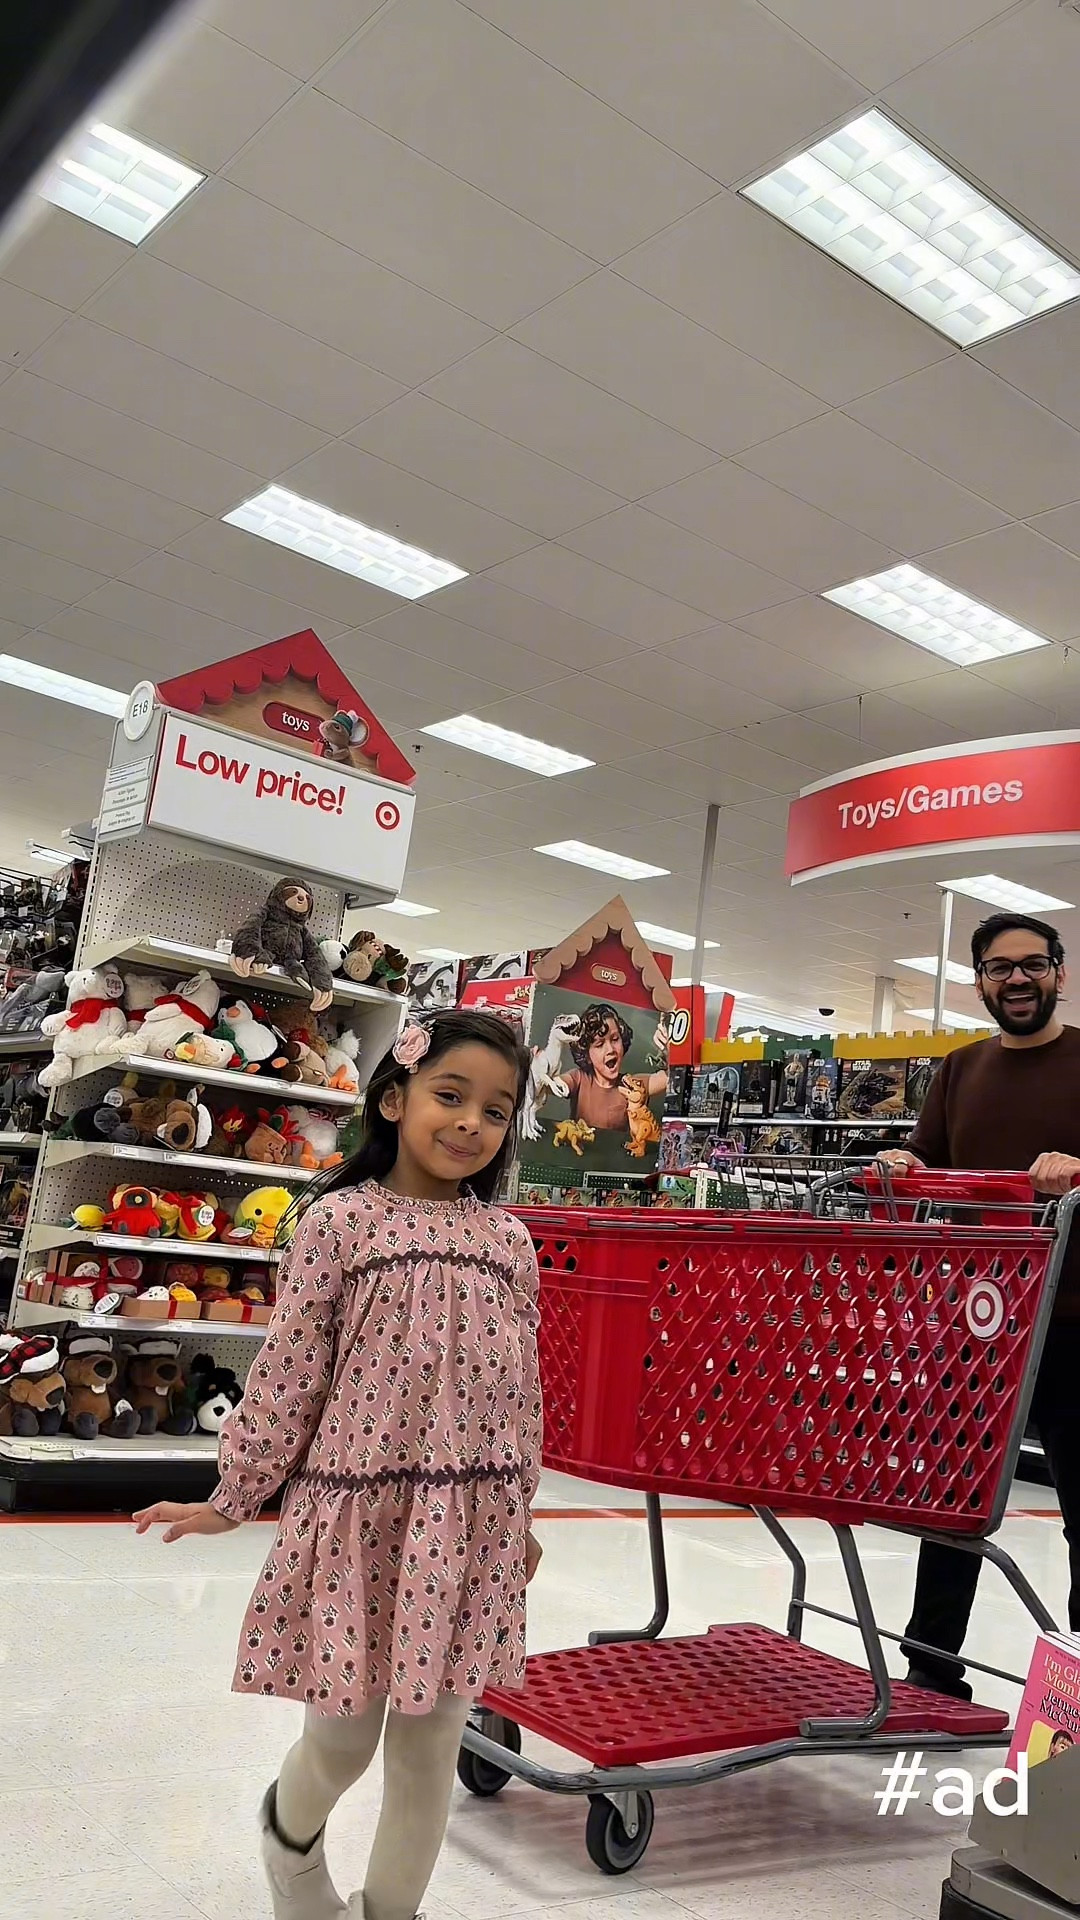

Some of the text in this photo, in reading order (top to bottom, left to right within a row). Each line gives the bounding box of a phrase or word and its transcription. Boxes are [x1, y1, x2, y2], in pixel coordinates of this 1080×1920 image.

[132, 700, 149, 718] E18
[282, 711, 310, 731] toys
[175, 734, 251, 784] Low
[255, 768, 347, 815] price!
[838, 779, 1024, 829] Toys/Games
[601, 969, 618, 982] toys
[1043, 1653, 1062, 1674] I'm
[1045, 1667, 1075, 1697] Mom
